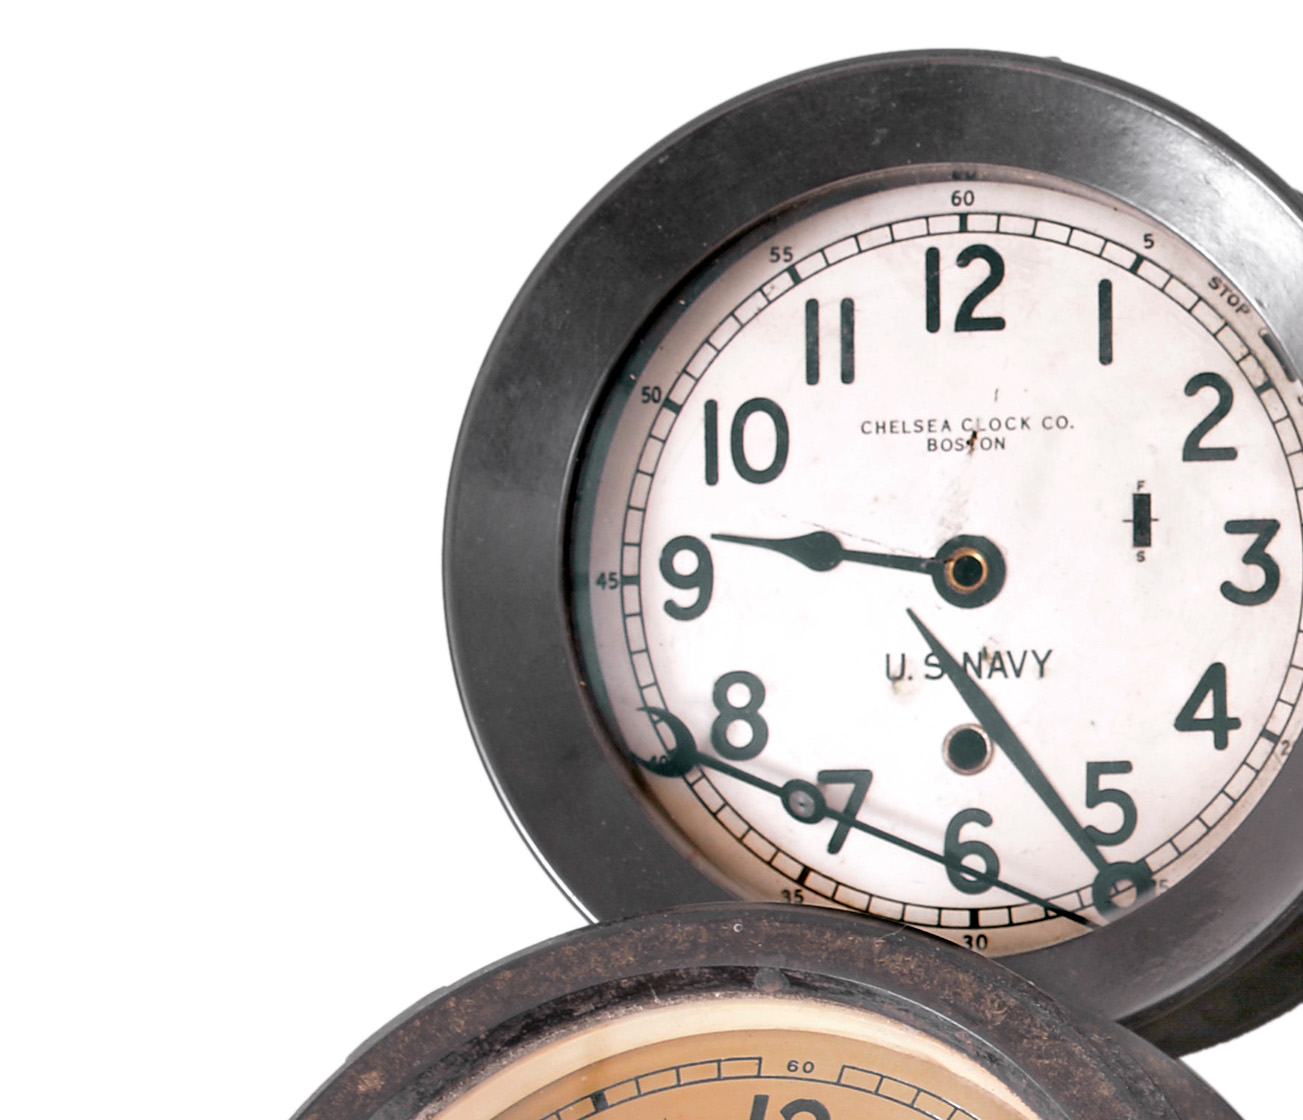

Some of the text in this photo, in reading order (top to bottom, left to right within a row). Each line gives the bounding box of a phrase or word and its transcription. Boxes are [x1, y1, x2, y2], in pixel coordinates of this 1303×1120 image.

[951, 191, 974, 206] 60
[1143, 233, 1154, 248] 5
[769, 246, 794, 263] 55
[925, 243, 1006, 333] 12
[1208, 277, 1250, 316] STOP
[641, 386, 662, 403] 50
[860, 416, 1075, 436] CHELSEA CLOCK CO.
[704, 397, 790, 486] 10
[927, 437, 1006, 452] BOSTON
[1137, 481, 1145, 491] F
[1136, 551, 1146, 563] S
[1219, 519, 1280, 606] 3
[596, 573, 619, 589] 45
[659, 535, 714, 621] 9
[964, 649, 1053, 680] NAVY
[944, 808, 1000, 895] 6
[781, 889, 804, 904] 35
[963, 934, 988, 951] 30
[787, 1060, 815, 1074] 60
